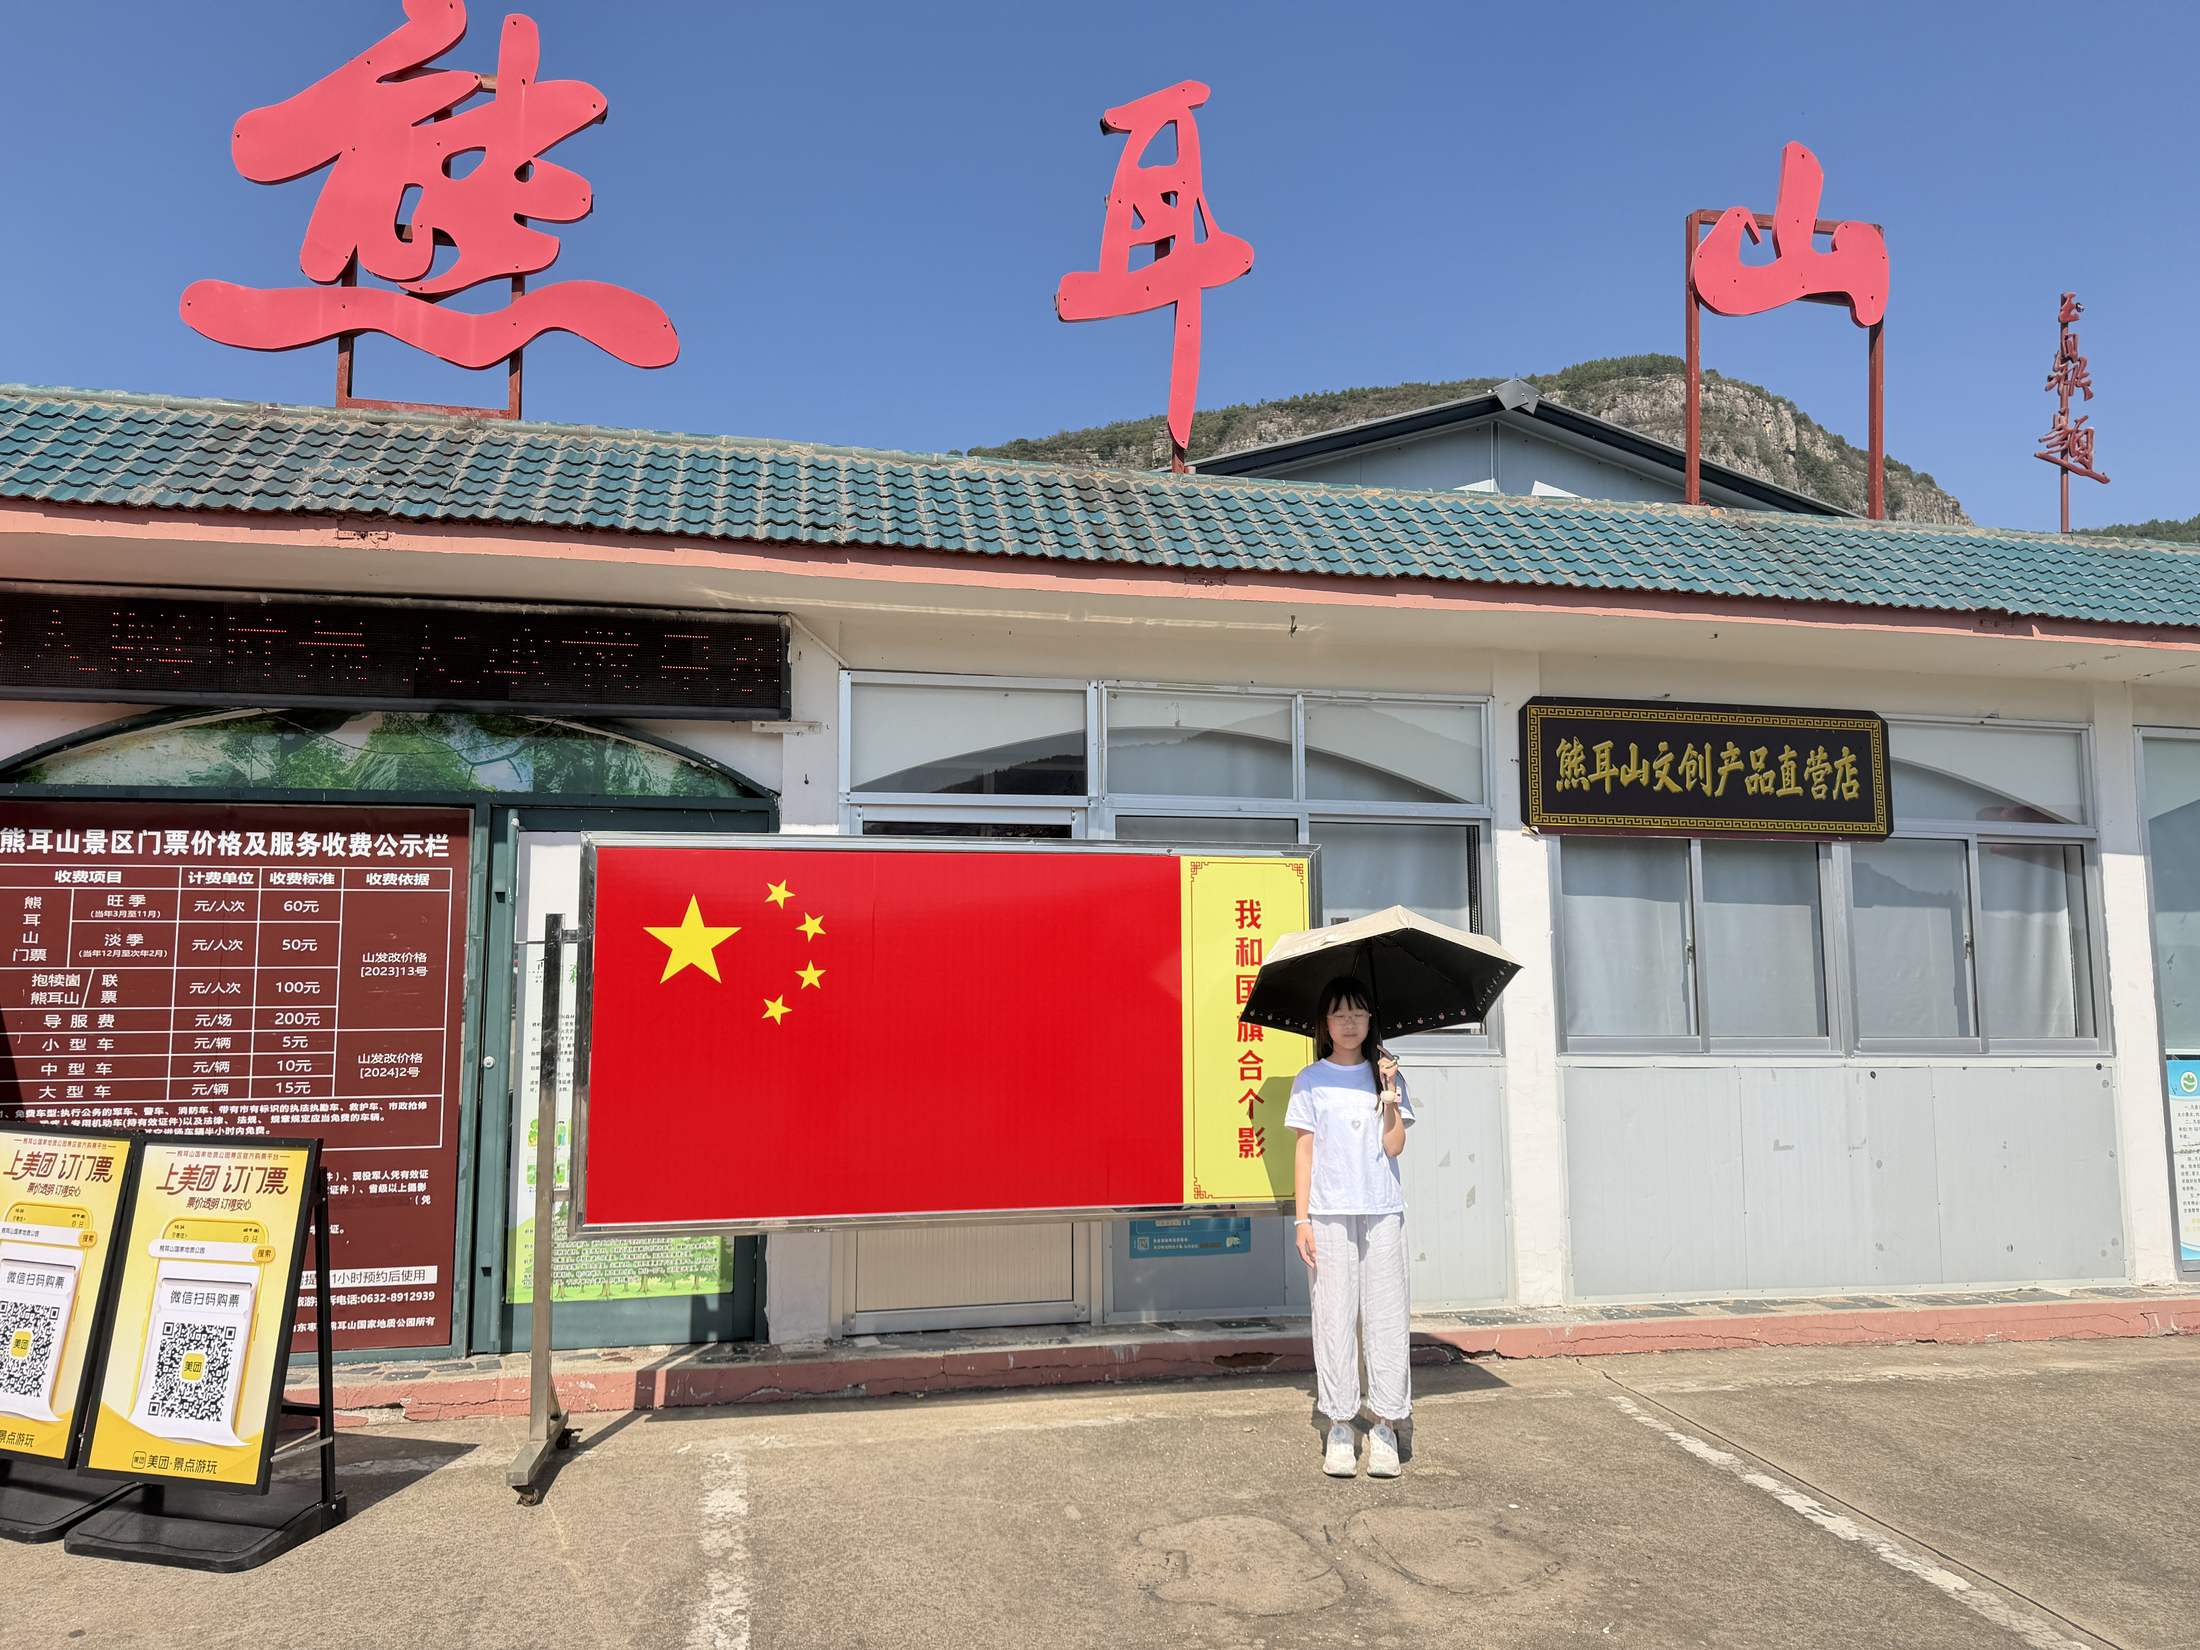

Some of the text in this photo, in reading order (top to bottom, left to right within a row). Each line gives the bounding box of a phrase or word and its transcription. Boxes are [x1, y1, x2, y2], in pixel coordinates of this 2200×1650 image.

[1555, 736, 1861, 801] 熊耳山文创产品直营店
[0, 827, 449, 858] 熊耳山景区门票价格及服务收费公示栏
[55, 870, 122, 884] 收费项目
[188, 871, 254, 885] 计费单位
[270, 871, 335, 886] 收费标准
[366, 872, 430, 886] 收费依据
[194, 900, 245, 912] 元/人次
[283, 900, 319, 913] 60元
[90, 910, 161, 919] (当年3月至11月)
[192, 938, 243, 951] 元/人次
[282, 938, 318, 951] 50元
[78, 949, 168, 958] (当年12月至次年2月)
[362, 952, 427, 963] 山发改价格
[360, 966, 428, 977] [2023]13号
[32, 974, 80, 987] 抱犊崮
[189, 982, 241, 994] 元/人次
[275, 981, 320, 994] 100元
[31, 992, 79, 1005] 熊耳山
[195, 1013, 232, 1027] 元/场
[275, 1012, 320, 1026] 200元
[194, 1037, 231, 1049] 元/辆
[282, 1035, 308, 1048] 5元
[358, 1053, 423, 1064] 山发改价格
[193, 1061, 230, 1073] 元/辆
[277, 1059, 312, 1072] 10元
[360, 1067, 420, 1079] [2024]2号
[192, 1083, 229, 1095] 元/辆
[276, 1081, 311, 1094] 15元
[3, 1150, 114, 1183] 上美团 订门票
[156, 1163, 289, 1195] 上美团 订门票
[328, 1182, 427, 1195] 证件）、省级以上摄影
[186, 1196, 251, 1211] 票价透明 订得安心
[7, 1271, 65, 1289] 微信扫码购票
[170, 1290, 240, 1307] 微信扫码购票
[184, 1361, 202, 1373] 美团
[147, 1455, 218, 1474] 美团·景点游玩
